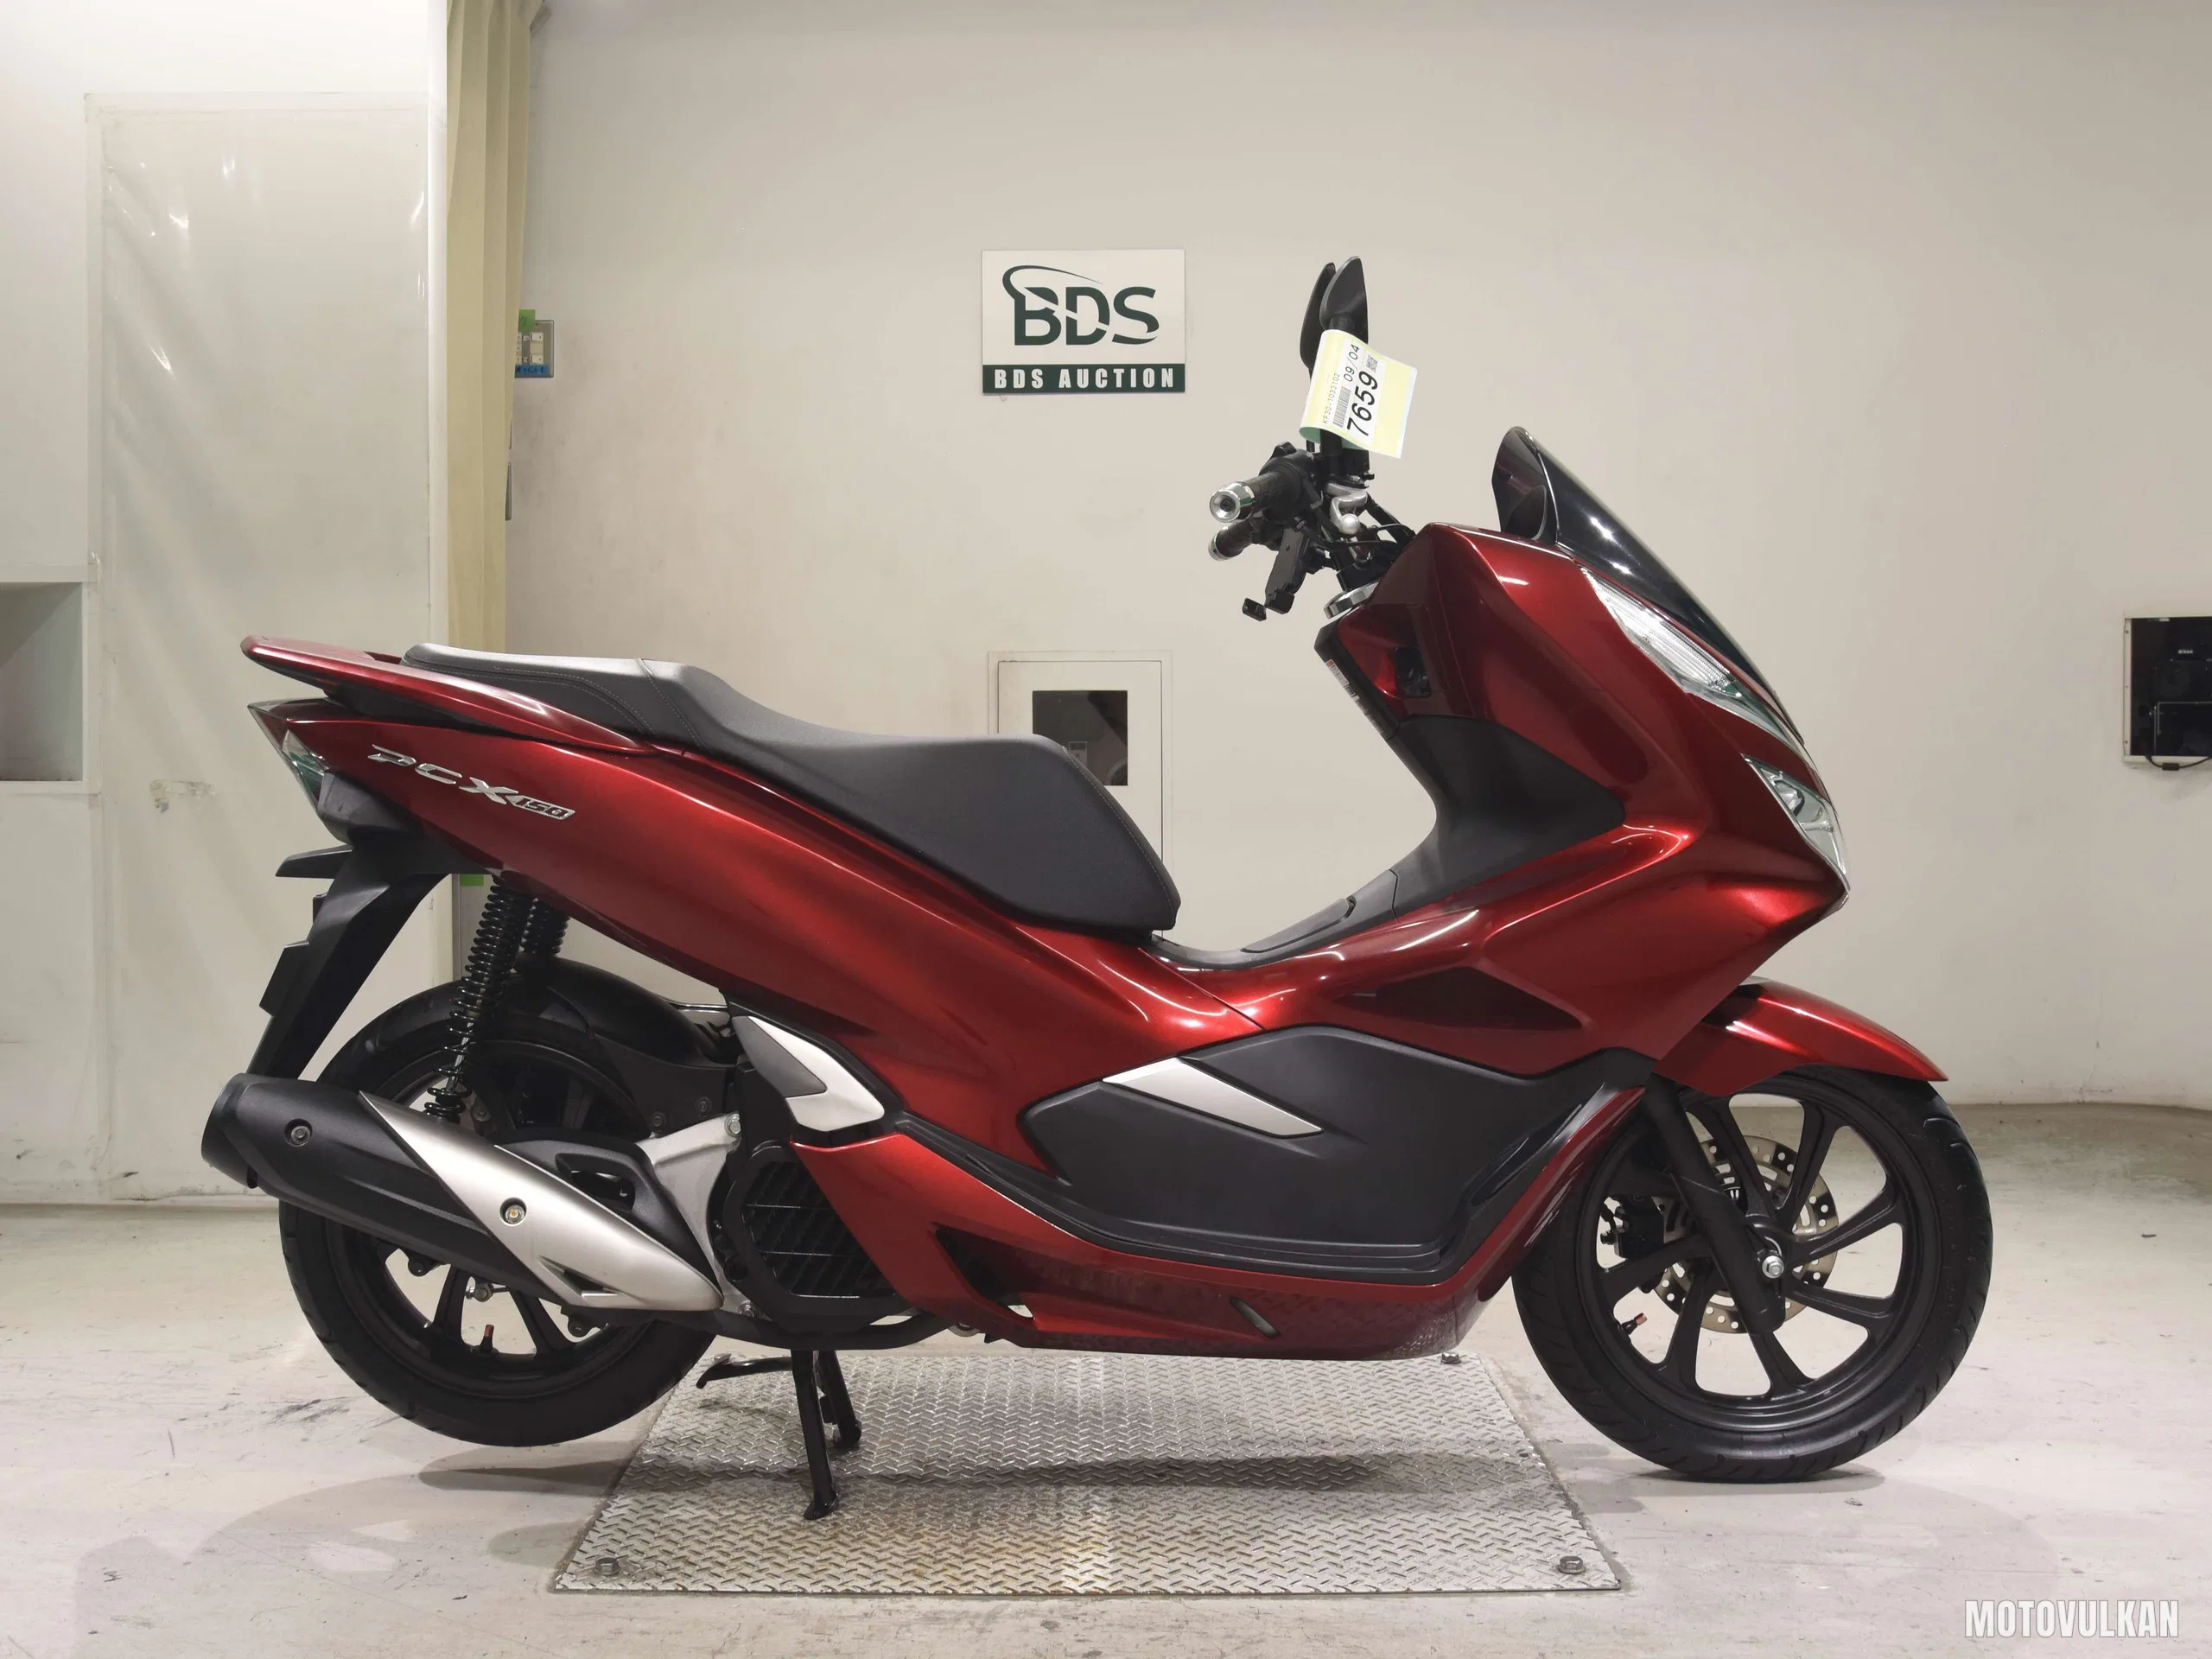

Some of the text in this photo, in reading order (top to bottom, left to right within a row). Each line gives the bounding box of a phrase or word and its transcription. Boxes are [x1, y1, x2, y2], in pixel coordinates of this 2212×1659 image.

[1002, 265, 1160, 346] BDS
[995, 368, 1173, 389] BDS AUCTION
[1344, 344, 1360, 382] 09/04
[1346, 371, 1378, 436] 7659
[367, 744, 570, 819] PCX 150
